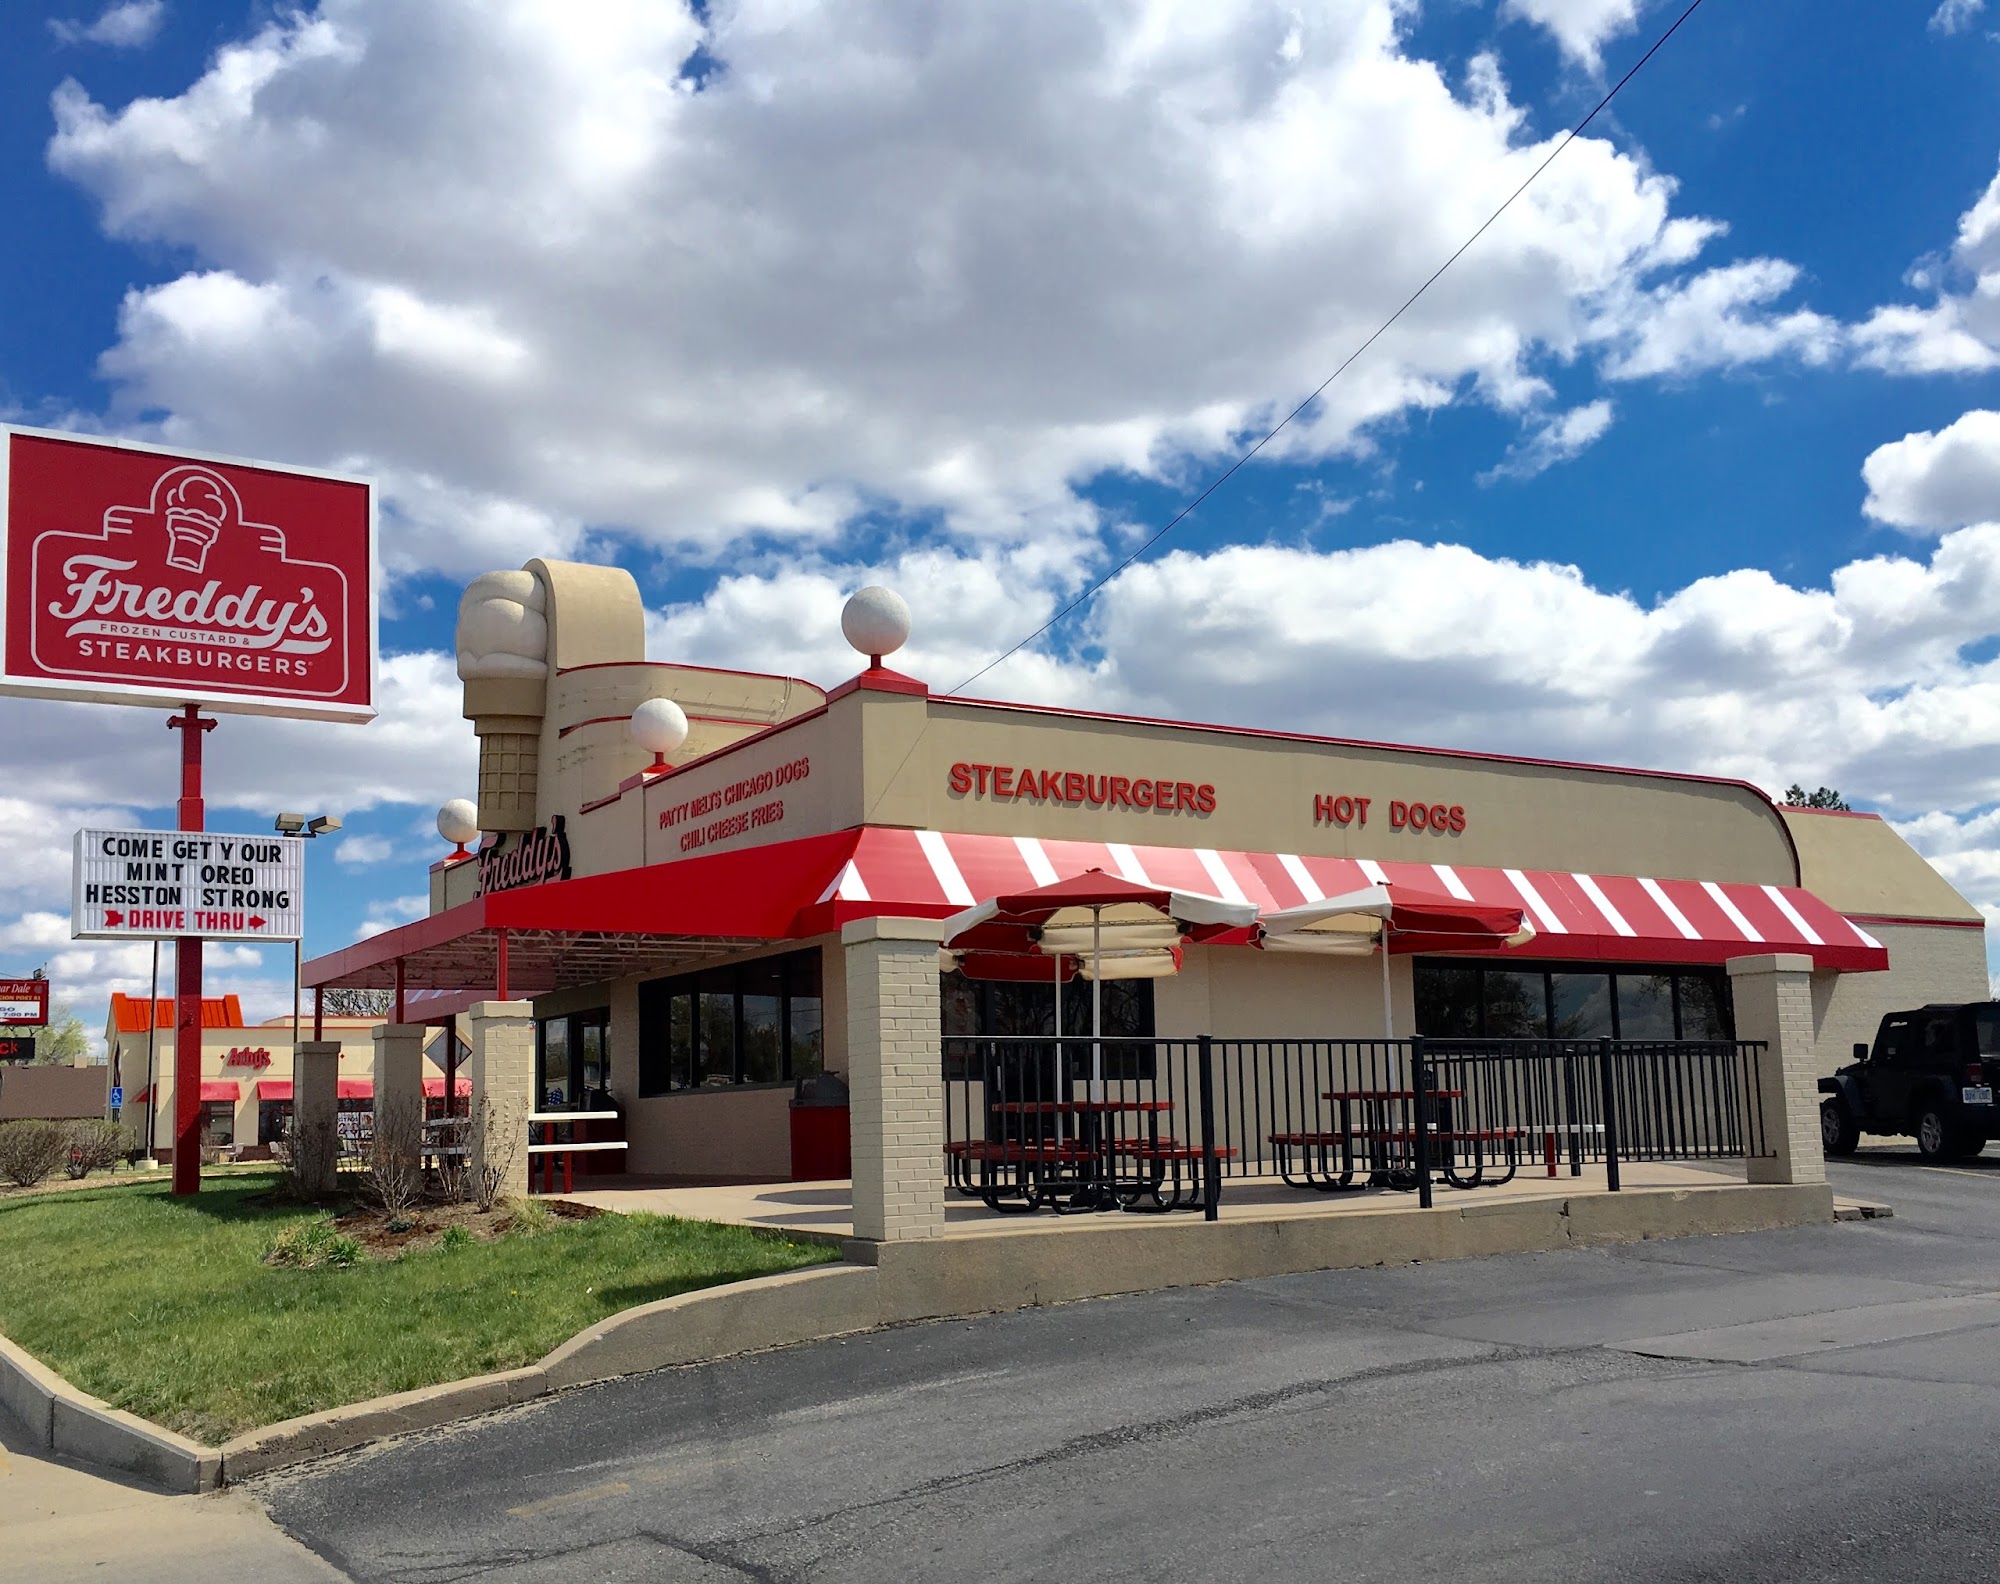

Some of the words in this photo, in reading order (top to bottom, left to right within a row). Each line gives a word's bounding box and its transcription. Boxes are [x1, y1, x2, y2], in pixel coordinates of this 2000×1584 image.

[49, 555, 331, 652] Freddy's
[100, 624, 161, 637] FROZEN
[169, 630, 236, 644] CUSTARD
[242, 638, 250, 646] &
[78, 639, 308, 676] STEAKBURGERS
[659, 802, 689, 830] PATTY
[691, 790, 722, 818] MELTS
[724, 771, 773, 806] CHICAGO
[775, 757, 810, 788] DOGS
[949, 762, 1217, 813] STEAKBURGERS
[680, 825, 705, 852] CHILI
[707, 811, 749, 843] CHEESE
[751, 800, 784, 829] FRIES
[1314, 793, 1371, 824] HOT
[1390, 800, 1467, 832] DOGS
[102, 837, 163, 859] COME
[173, 840, 212, 860] GET
[474, 815, 566, 898] Freddy's
[127, 863, 184, 882] MINT
[201, 865, 254, 885] OREO
[86, 884, 181, 905] HESSTON
[202, 889, 289, 909] STRONG
[129, 910, 185, 929] DRIVE
[194, 911, 244, 931] THRU
[11, 983, 31, 993] Dale
